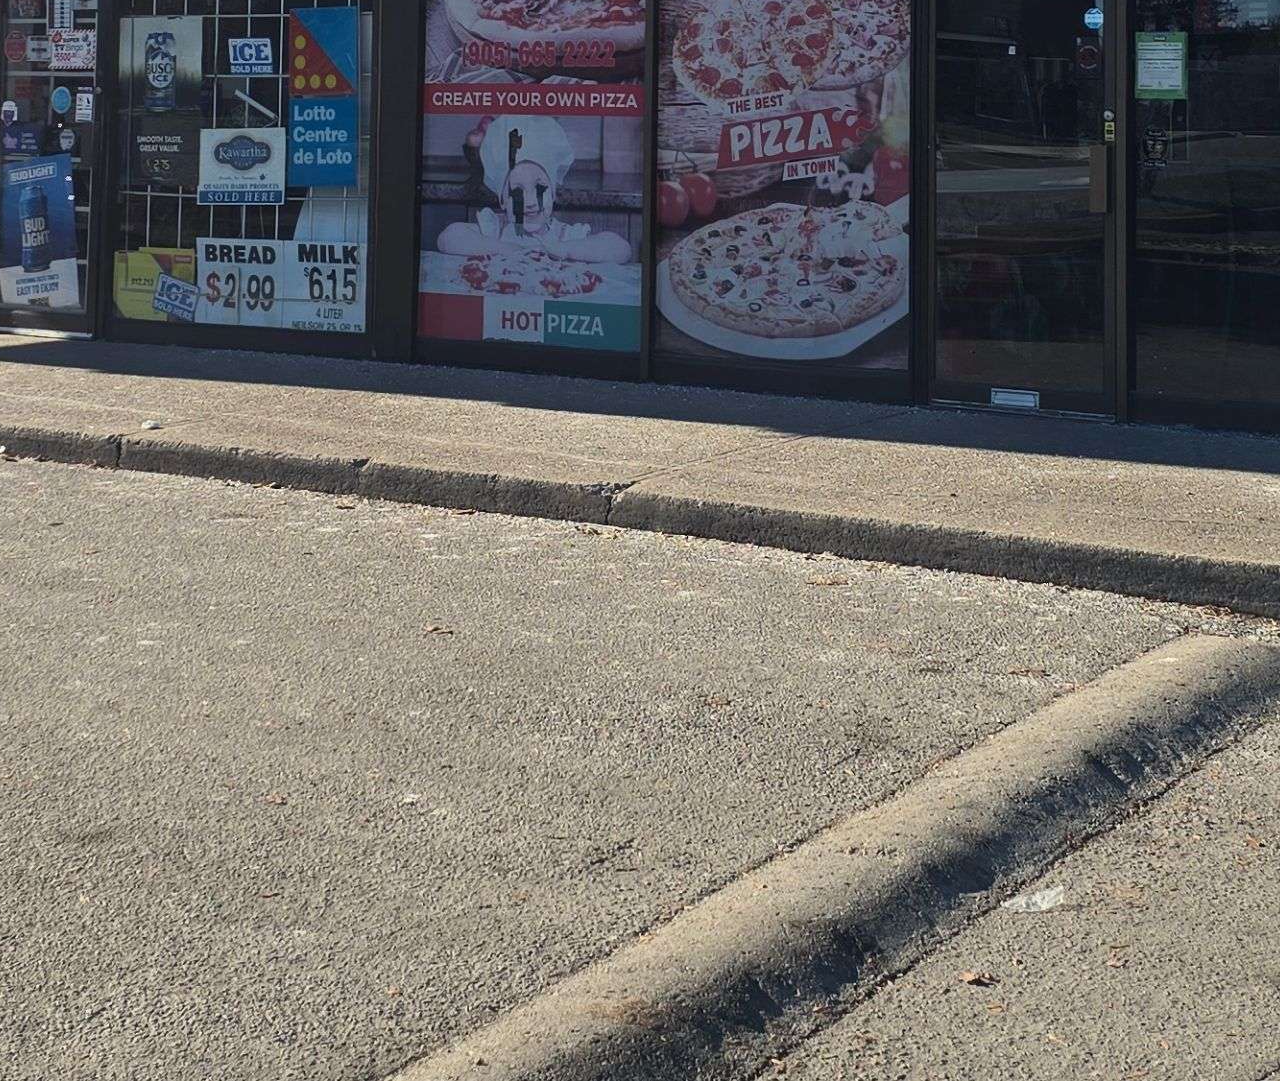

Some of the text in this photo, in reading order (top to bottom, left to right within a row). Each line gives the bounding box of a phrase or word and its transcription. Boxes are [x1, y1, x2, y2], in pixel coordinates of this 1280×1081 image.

[232, 40, 269, 62] ICE
[519, 41, 557, 67] 665
[563, 40, 616, 67] 2222
[231, 65, 272, 73] SOLD HERE
[152, 75, 169, 83] ICE
[432, 92, 638, 108] CREATE YOUR OWN PIZZA
[727, 93, 784, 114] THE BEST
[294, 105, 336, 121] Lotto
[293, 126, 348, 142] Centre
[730, 113, 833, 162] PIZZA
[218, 145, 267, 160] Kawartha
[293, 149, 352, 164] de Loto
[28, 165, 55, 179] LIGHT
[787, 159, 837, 178] IN TOWN
[207, 192, 276, 202] SOLD HERE
[24, 216, 45, 233] BUD
[22, 230, 50, 248] LIGHT
[205, 244, 276, 264] BREAD
[298, 243, 361, 265] MILK
[157, 279, 196, 309] ICE
[206, 271, 275, 311] $2.99
[303, 267, 357, 305] $6.15
[315, 307, 344, 319] 4 LITER
[291, 320, 324, 330] NEILSON
[501, 310, 604, 336] HOT PIZZA
